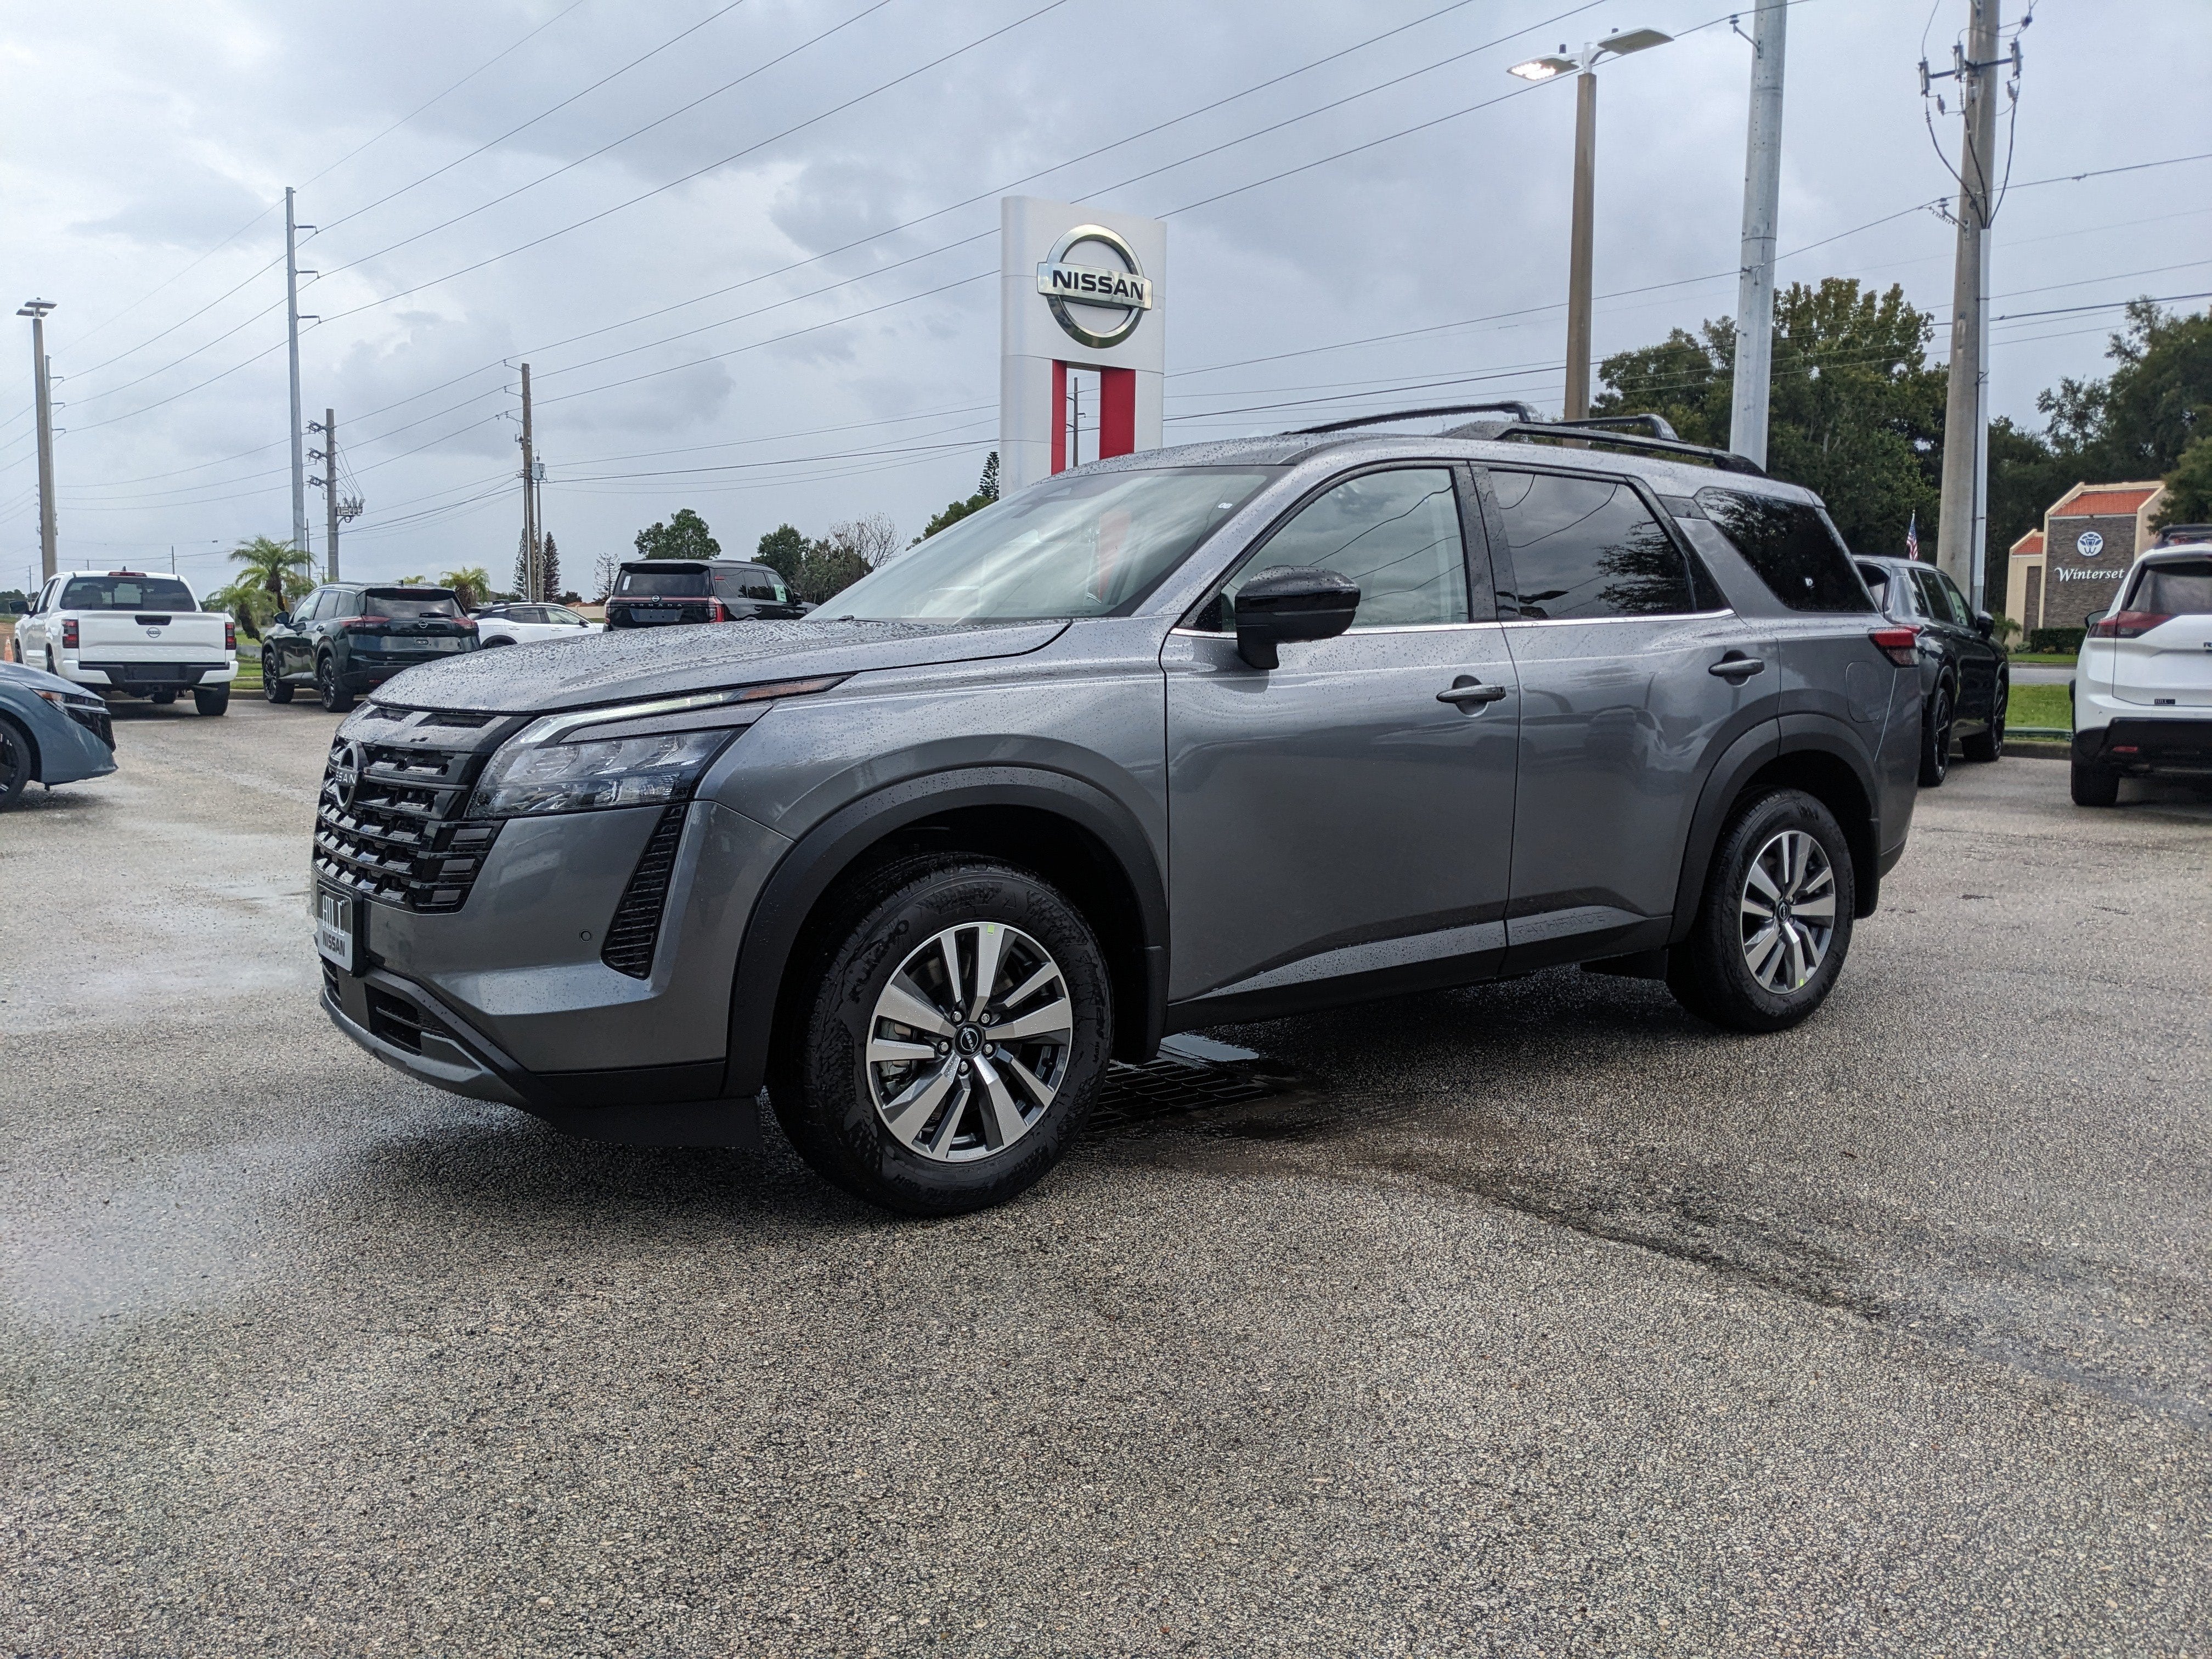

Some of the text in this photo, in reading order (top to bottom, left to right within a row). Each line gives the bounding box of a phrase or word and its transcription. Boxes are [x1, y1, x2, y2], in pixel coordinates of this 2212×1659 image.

[1052, 270, 1144, 301] NISSAN
[2054, 567, 2125, 582] Winterset
[321, 894, 345, 937] HILL
[323, 930, 345, 957] NISSAN
